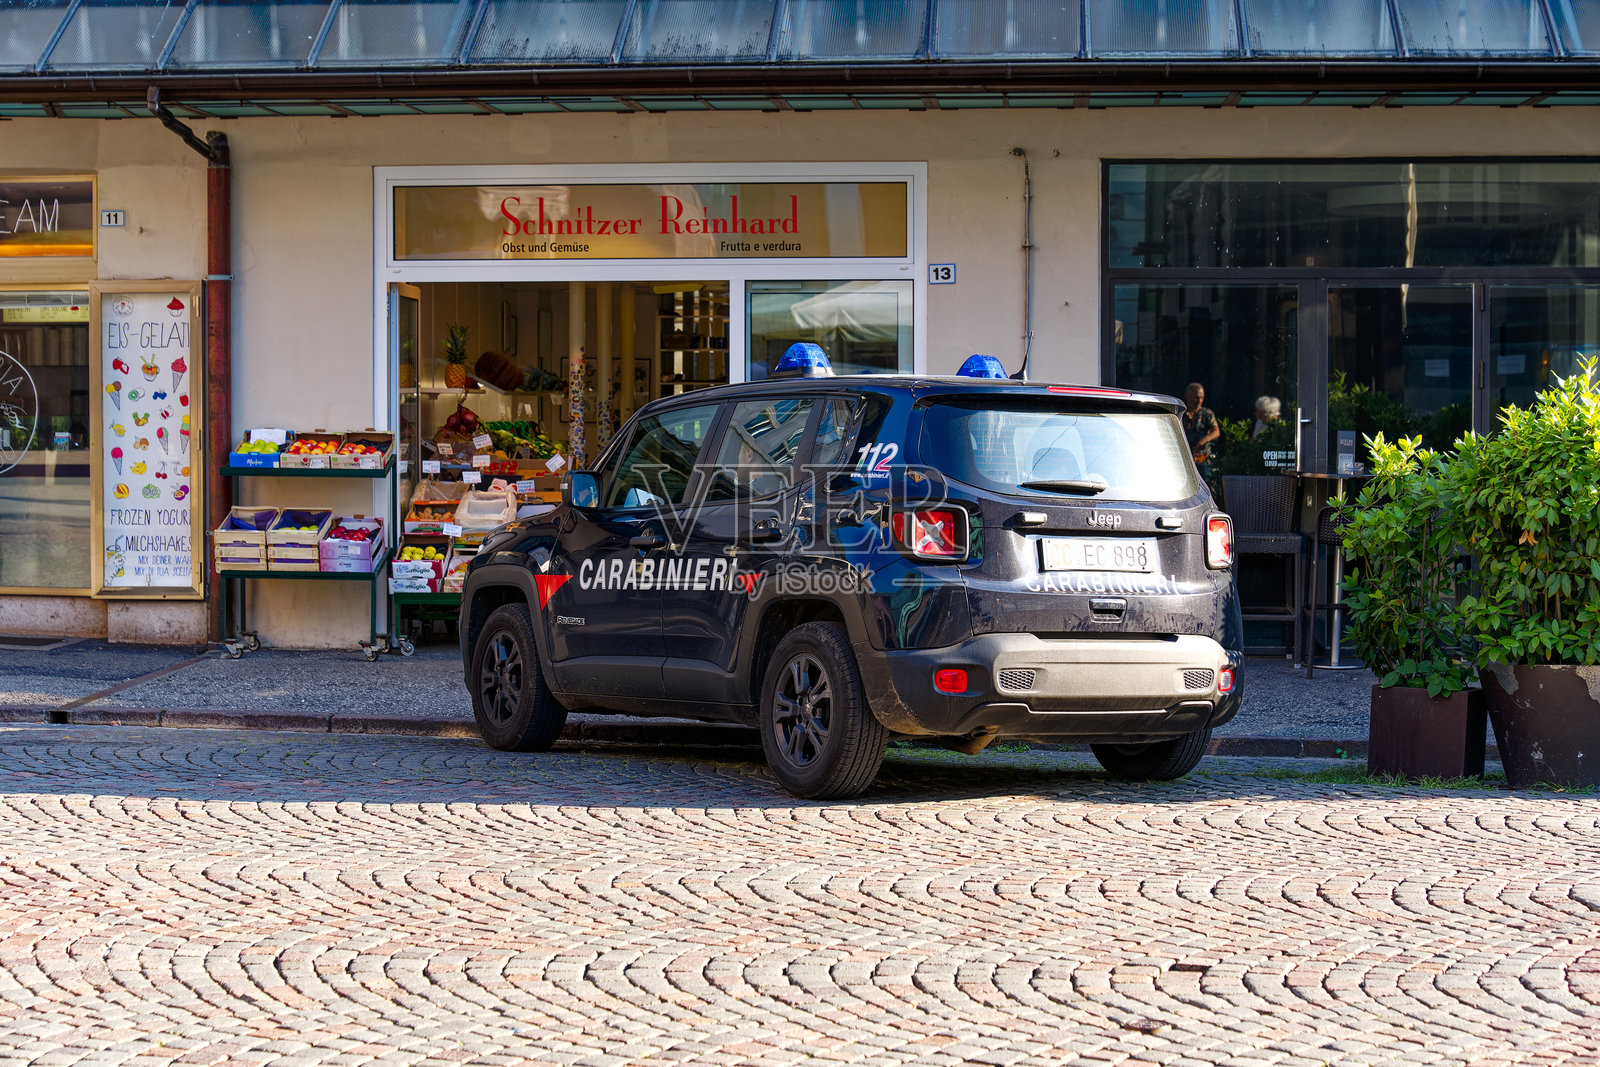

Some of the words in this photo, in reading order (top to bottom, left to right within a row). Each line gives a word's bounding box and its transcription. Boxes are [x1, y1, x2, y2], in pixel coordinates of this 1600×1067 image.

[106, 212, 118, 225] 11
[501, 196, 642, 236] Schnitzer
[658, 194, 801, 234] Reinhard
[502, 242, 525, 253] Obst
[528, 242, 547, 253] und
[549, 242, 590, 253] Gemüse
[720, 241, 751, 252] Frutta
[753, 243, 760, 252] e
[762, 241, 802, 252] verdura
[931, 267, 951, 281] 13
[855, 442, 899, 472] 112
[1263, 450, 1278, 460] OPEN
[110, 508, 151, 526] FROZEN
[1087, 510, 1122, 529] Jeep
[1050, 543, 1073, 566] CC
[1083, 543, 1105, 567] EC
[1113, 544, 1148, 567] 898
[578, 557, 738, 591] CARABINIERI
[1025, 574, 1179, 595] CARABINIERI
